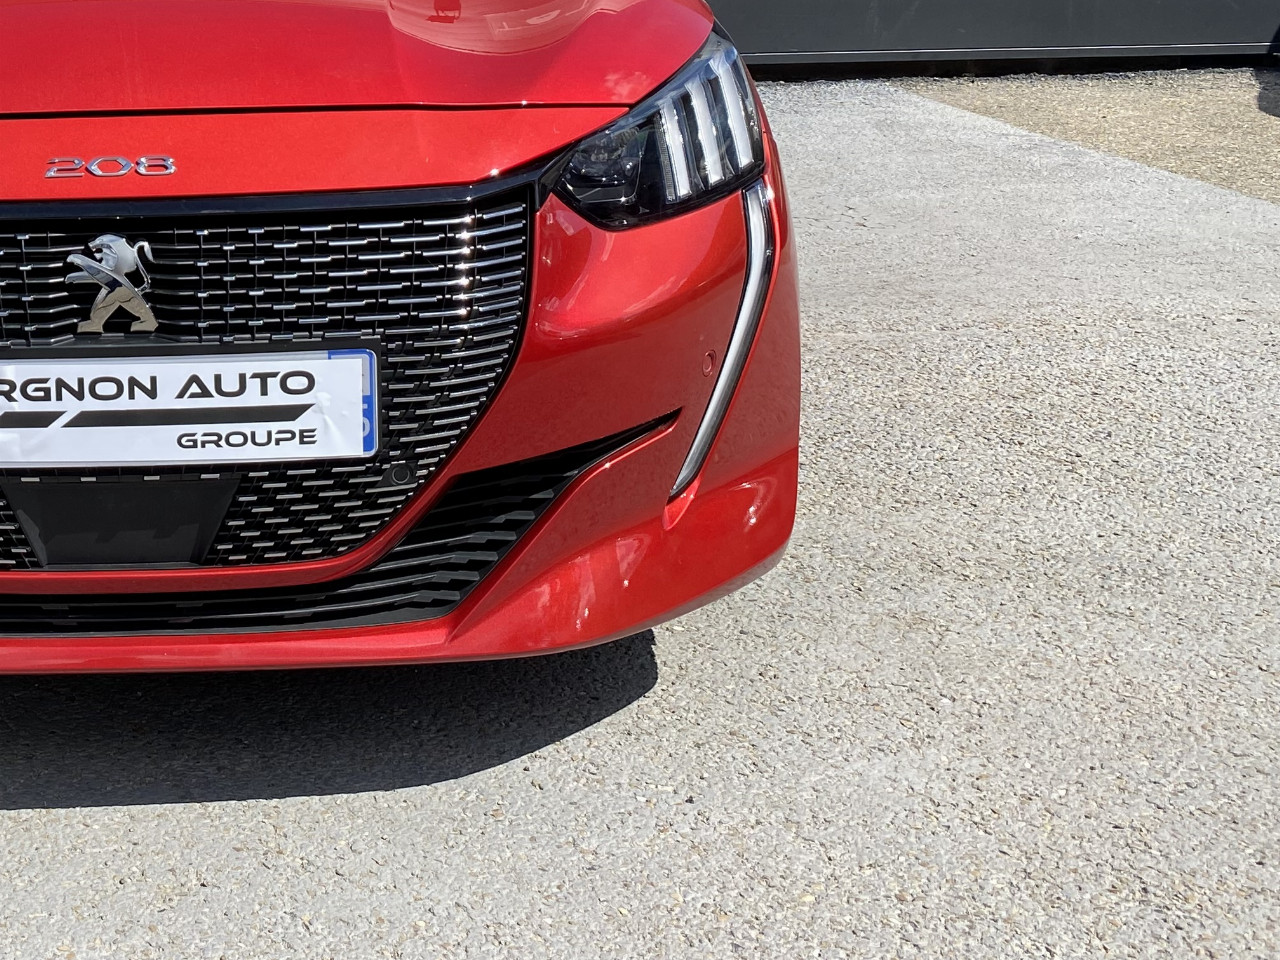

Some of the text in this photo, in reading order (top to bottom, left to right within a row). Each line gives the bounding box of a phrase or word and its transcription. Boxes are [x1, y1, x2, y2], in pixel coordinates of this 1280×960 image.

[44, 155, 178, 179] 208
[174, 369, 316, 400] AUTO
[176, 427, 318, 449] GROUPE
